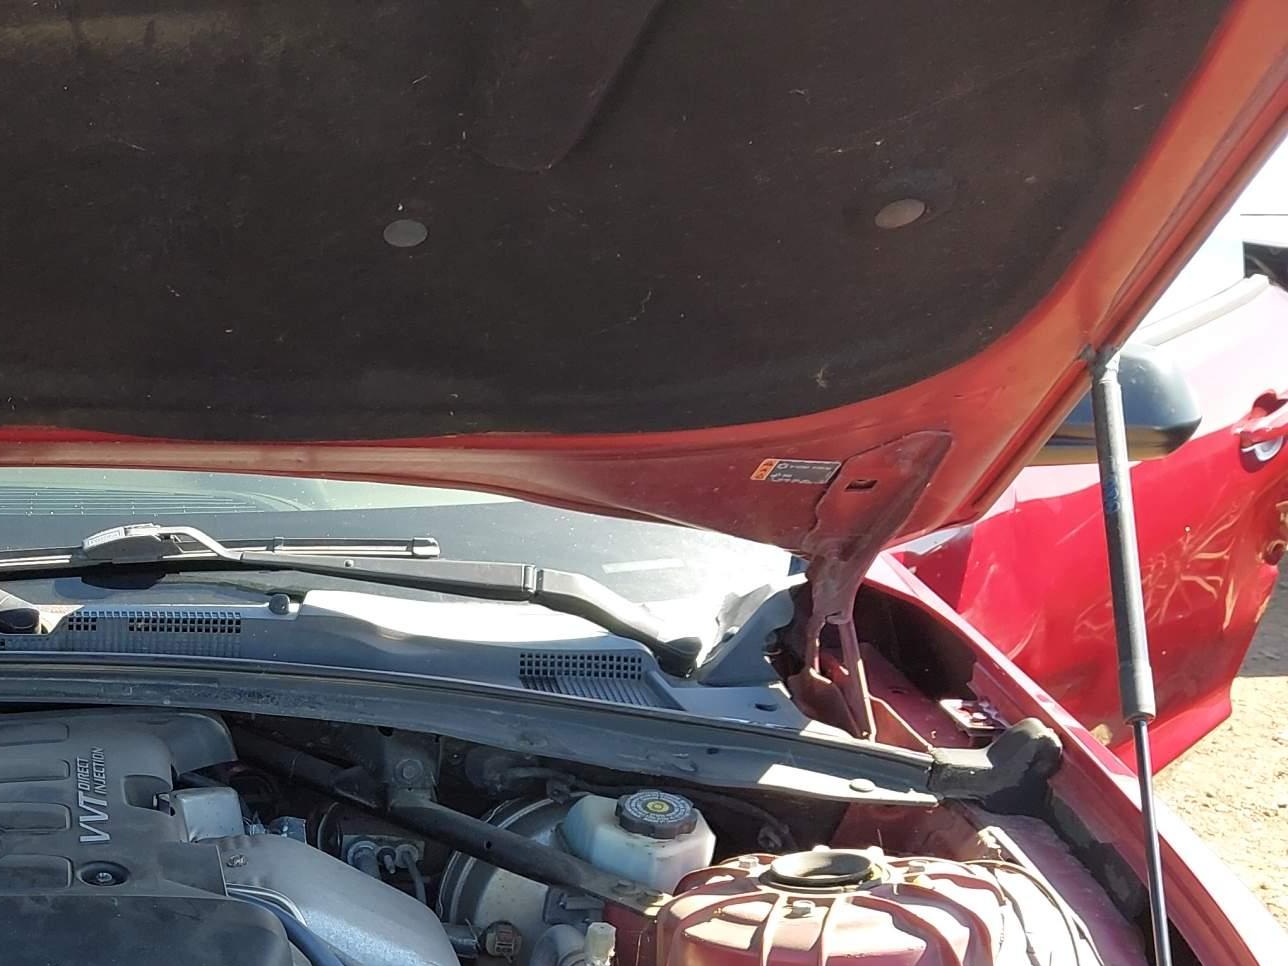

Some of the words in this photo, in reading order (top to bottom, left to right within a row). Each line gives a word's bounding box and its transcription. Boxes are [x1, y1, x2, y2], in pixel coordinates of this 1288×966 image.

[77, 756, 91, 791] DIRECT
[91, 745, 108, 795] INJECTION
[78, 790, 111, 843] VVT
